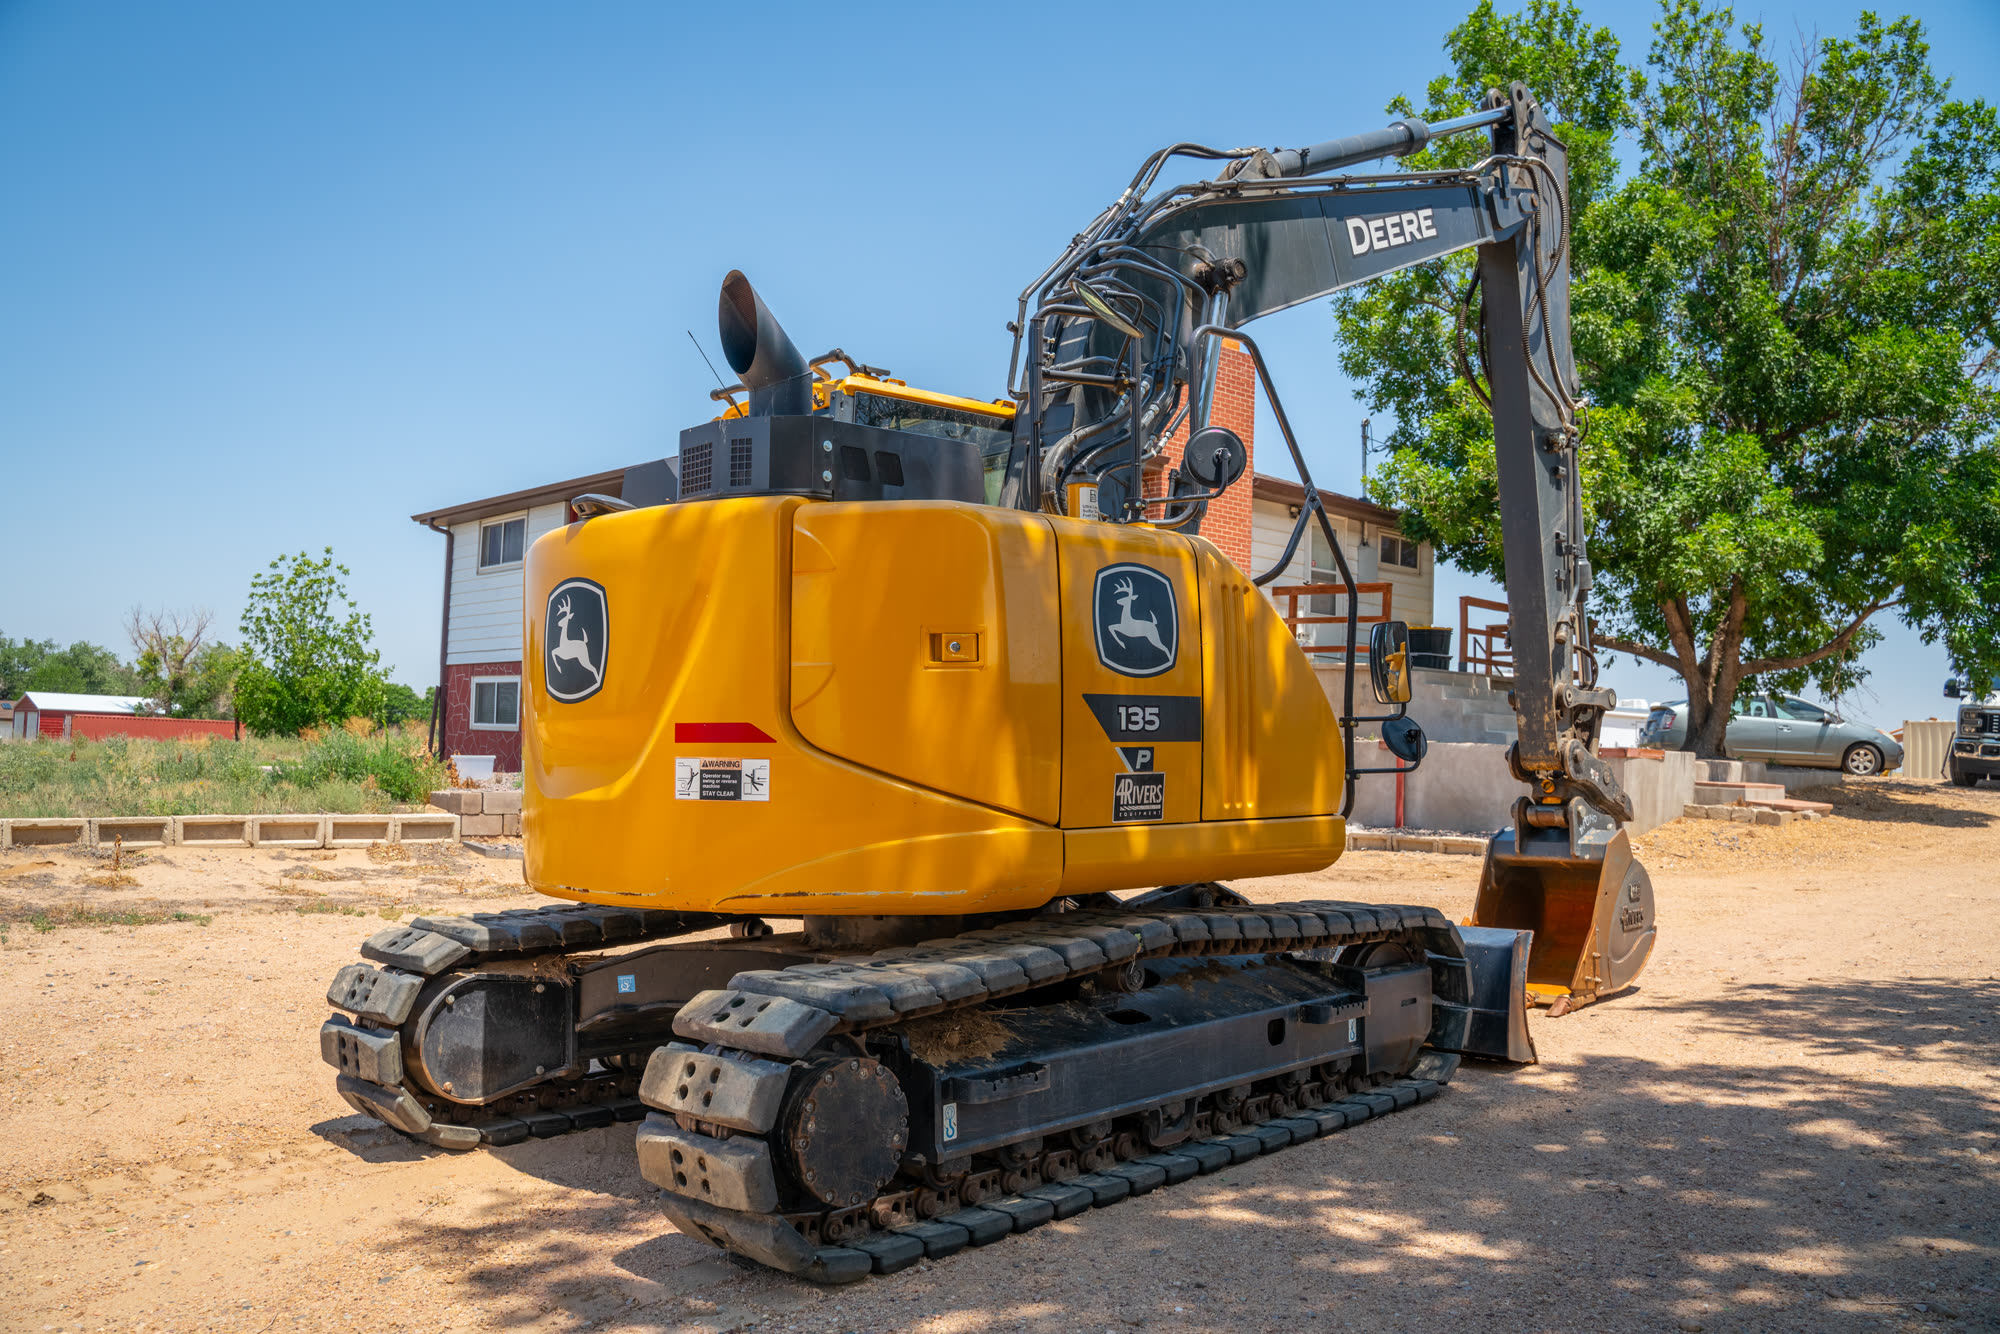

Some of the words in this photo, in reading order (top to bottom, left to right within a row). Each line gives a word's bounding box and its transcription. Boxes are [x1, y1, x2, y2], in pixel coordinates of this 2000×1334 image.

[1346, 208, 1438, 256] DEERE
[1118, 705, 1160, 732] 135
[708, 760, 740, 768] WARNING
[1136, 749, 1151, 769] P
